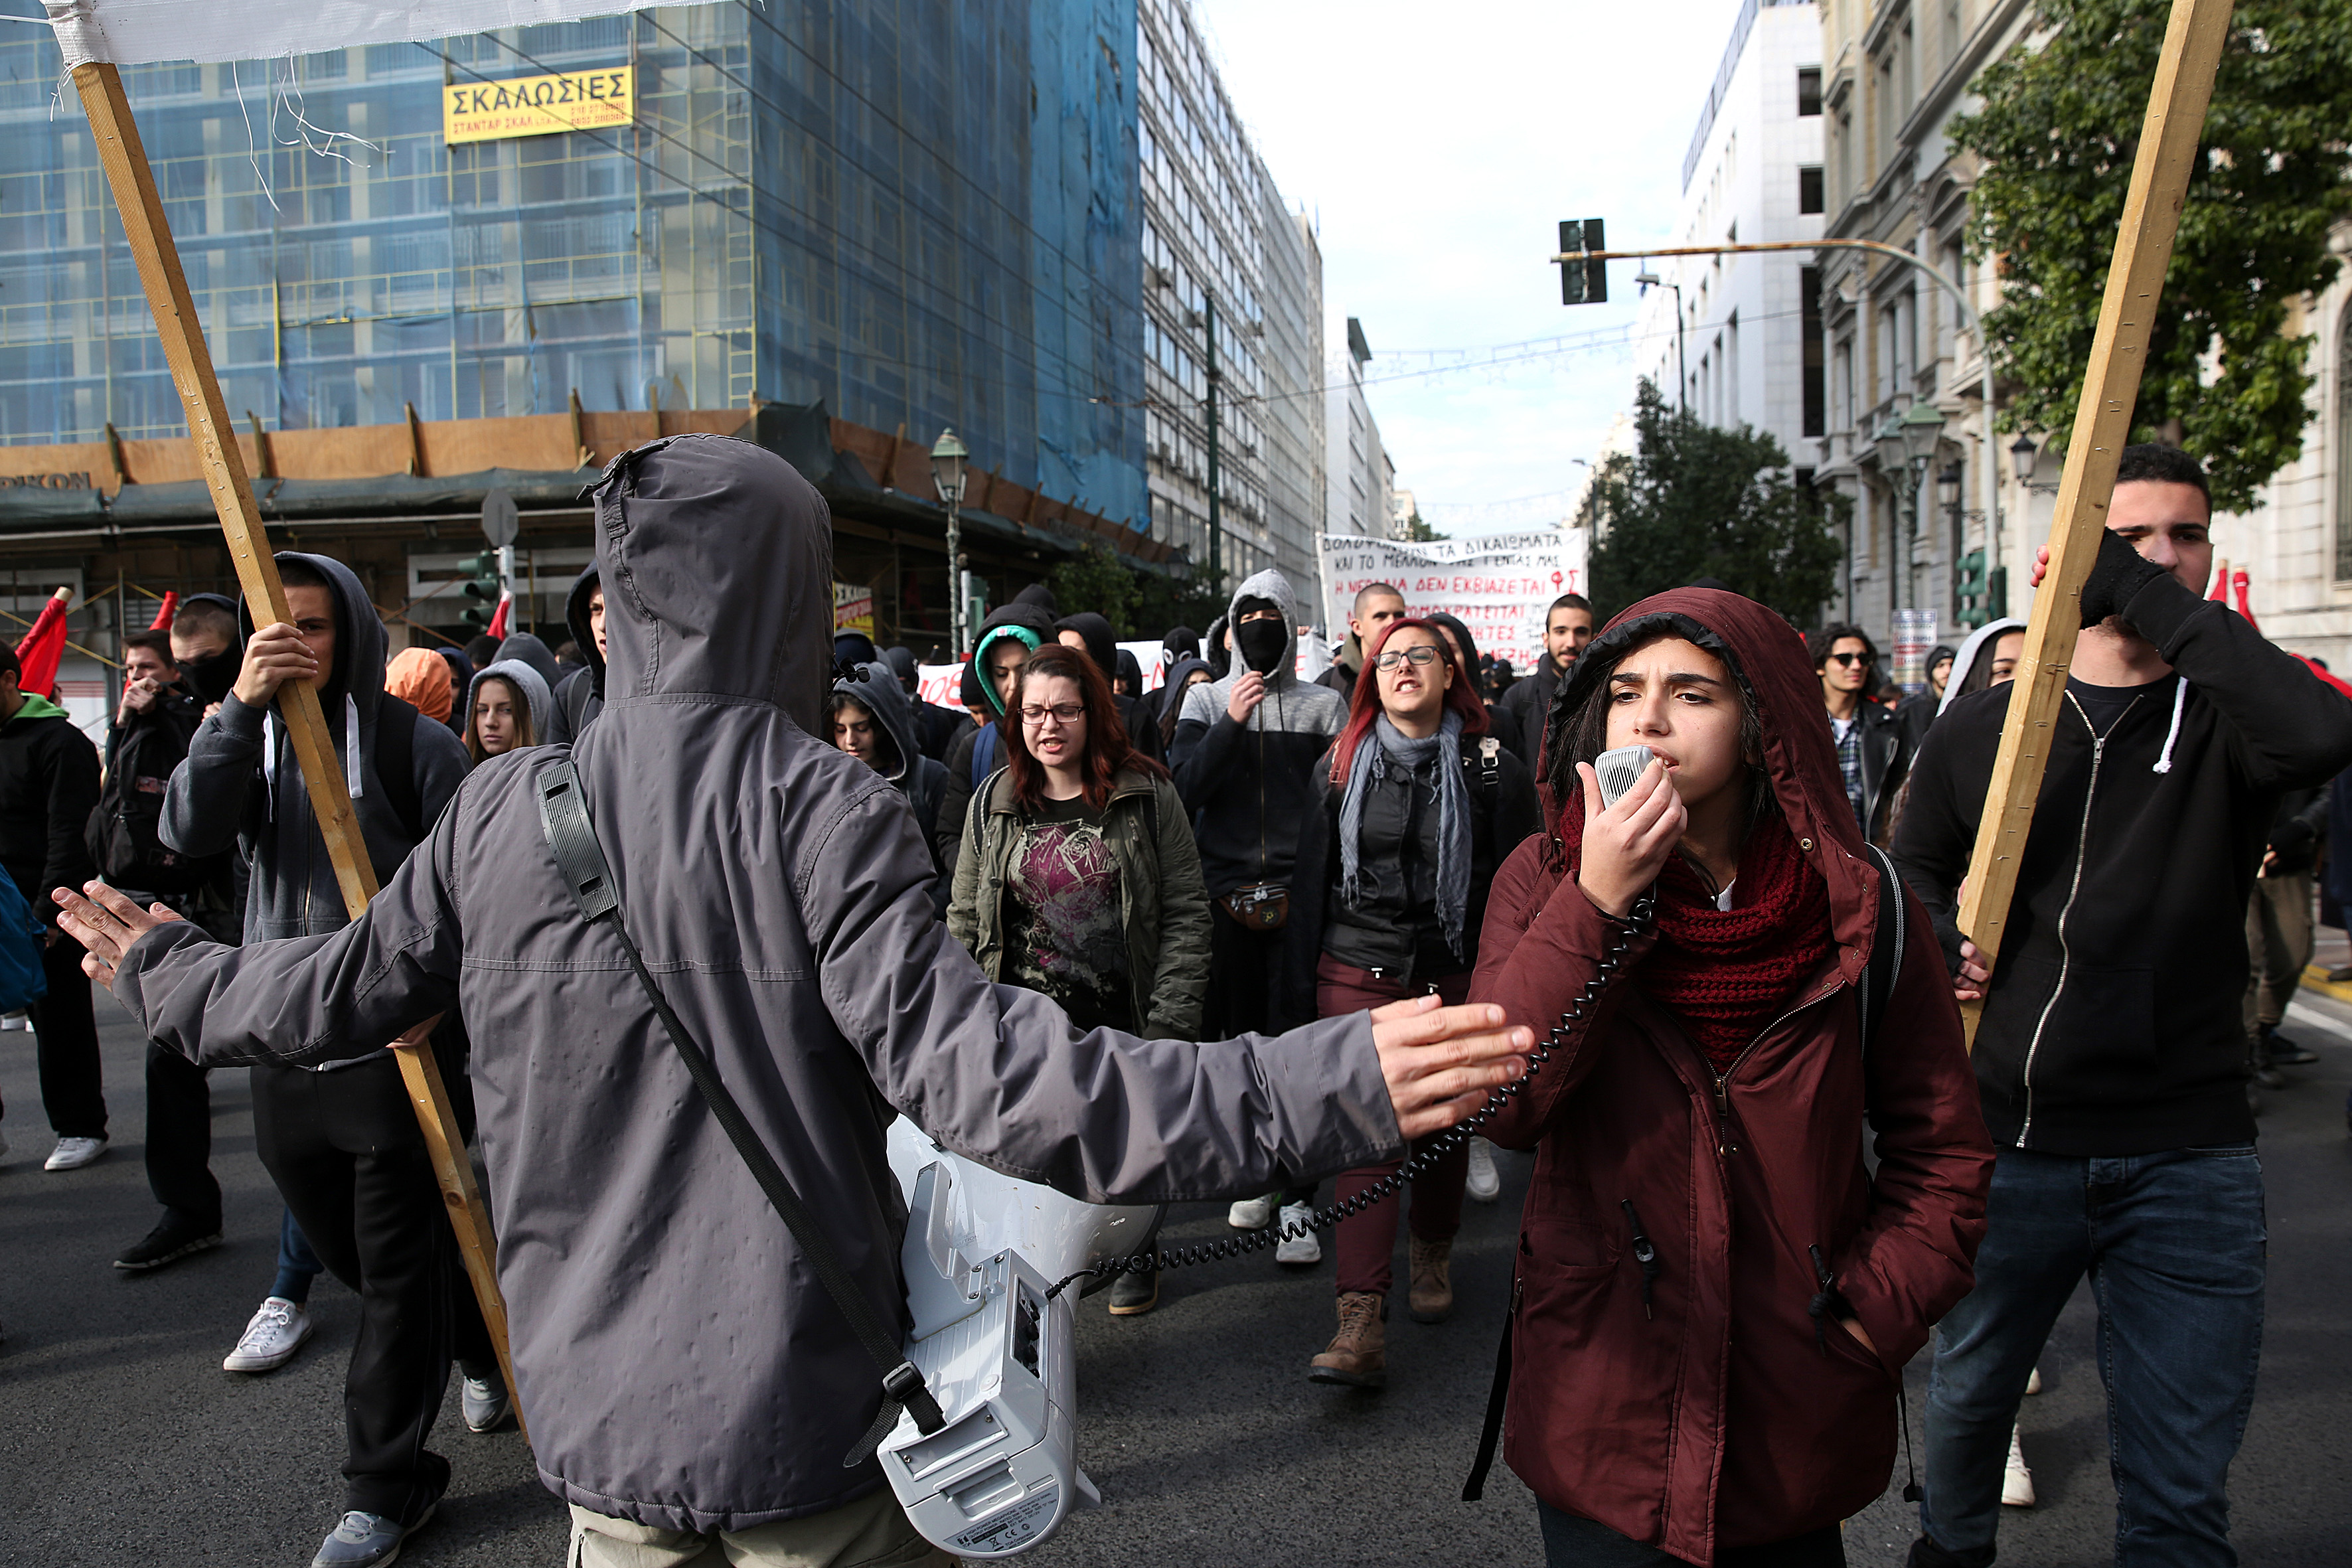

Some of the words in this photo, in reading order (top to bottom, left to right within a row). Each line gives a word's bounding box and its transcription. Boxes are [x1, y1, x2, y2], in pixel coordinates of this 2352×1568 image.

[453, 74, 625, 114] ΣΚΑΛΩΣΙΕΣ
[453, 118, 501, 134] ΣΤΑΝΤΑΡ
[1435, 544, 1456, 558] ΤΑ
[1465, 534, 1563, 554] ΔΙΚΑΙΩΜΑΤΑ
[1334, 556, 1353, 572] ΚΑΙ
[1360, 554, 1375, 570] ΤΟ
[1536, 555, 1561, 568] ΜΑΣ
[1334, 580, 1344, 595] Η
[1415, 576, 1448, 592] ΔΕΝ
[976, 1520, 991, 1530] POWER
[991, 1508, 1016, 1523] MEGAPHONE
[1014, 1530, 1035, 1543] Corporation
